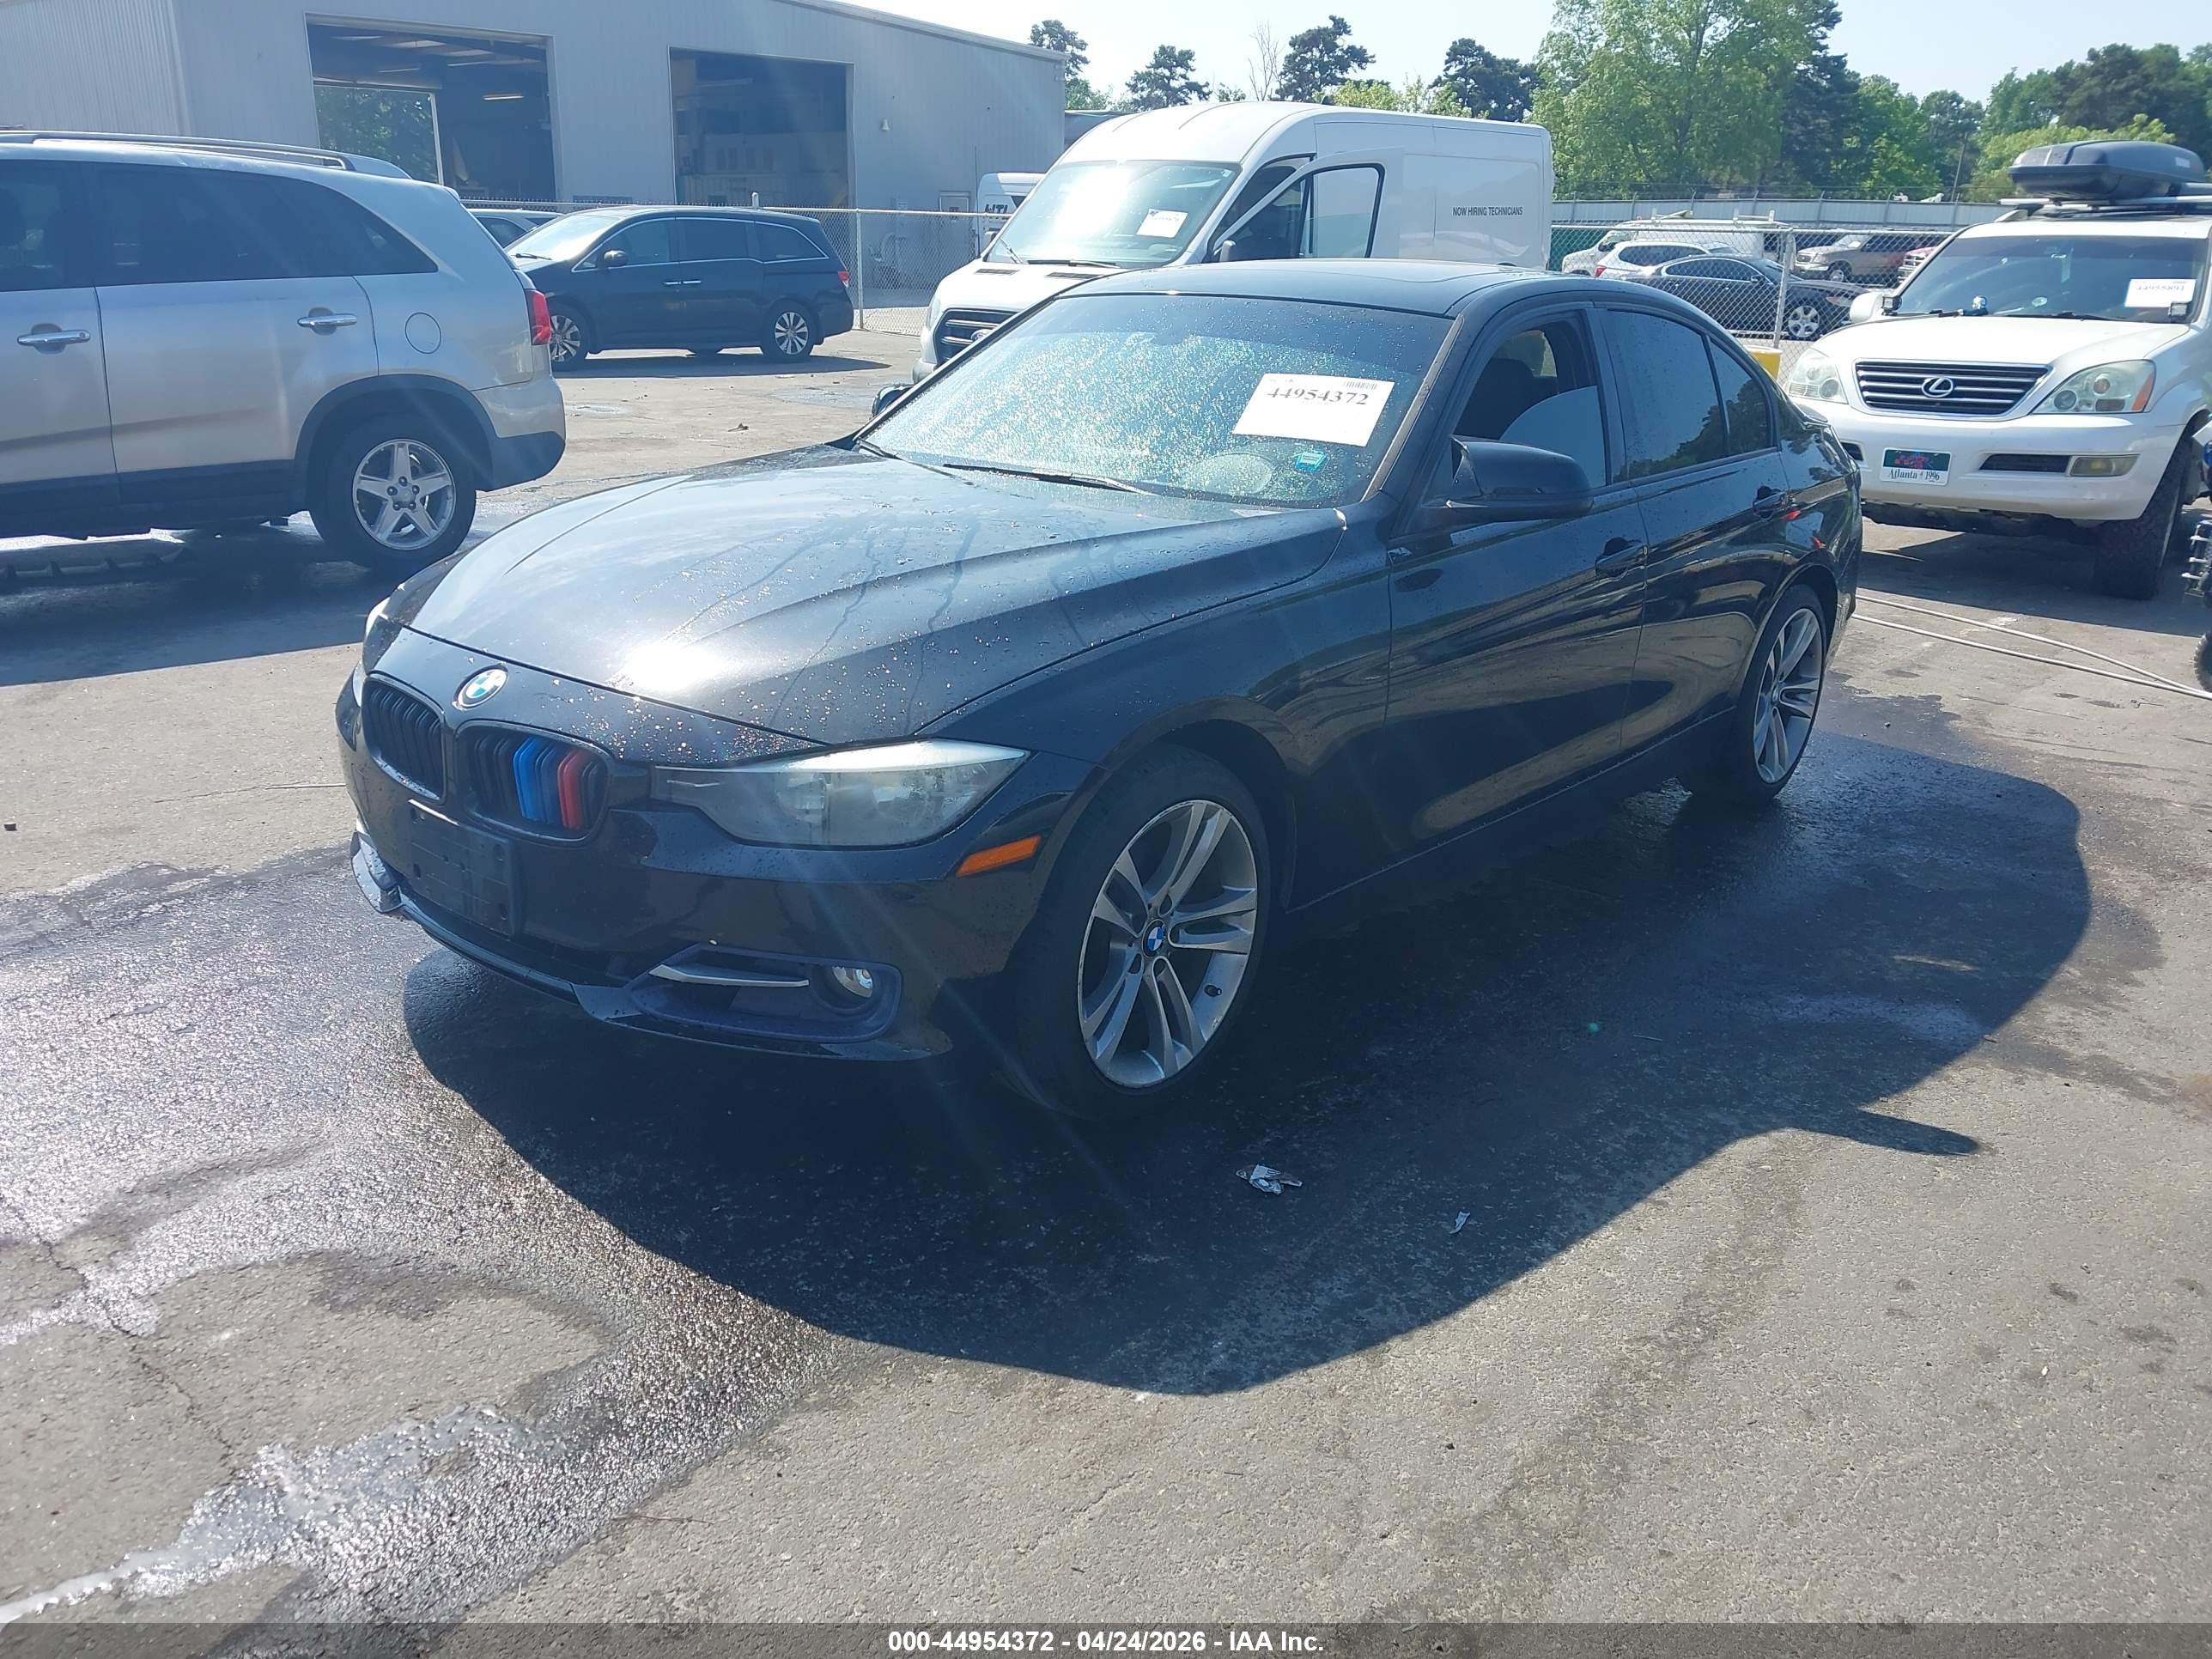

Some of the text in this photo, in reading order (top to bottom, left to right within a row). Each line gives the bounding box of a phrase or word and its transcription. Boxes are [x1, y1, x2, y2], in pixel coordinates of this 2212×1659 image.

[1452, 205, 1523, 216] NOW HIRING TECHNICIANS
[1267, 387, 1369, 405] 44954372
[1889, 468, 1940, 481] Atlanta 1996
